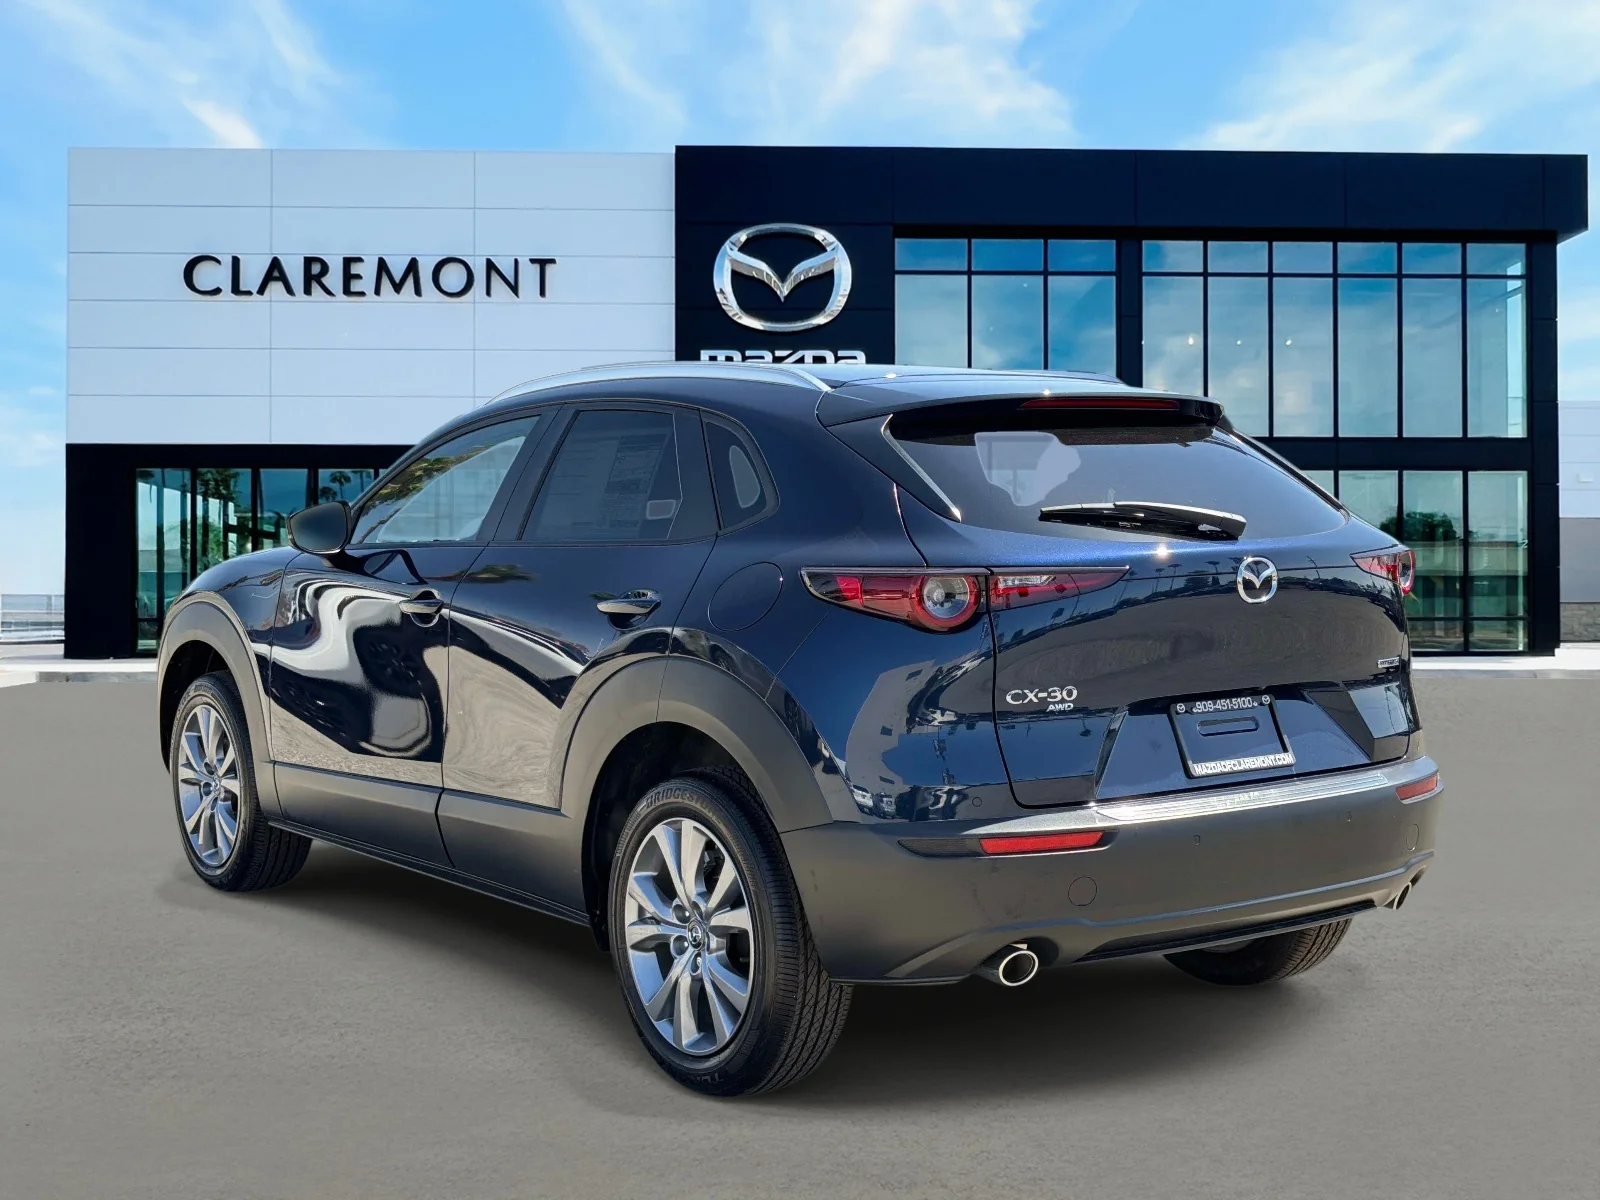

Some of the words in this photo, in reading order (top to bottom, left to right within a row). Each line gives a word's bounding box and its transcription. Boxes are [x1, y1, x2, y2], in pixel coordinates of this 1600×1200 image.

[183, 255, 557, 298] CLAREMONT
[1005, 685, 1078, 705] CX-30
[1046, 703, 1074, 712] AWD
[1196, 697, 1252, 712] 909-451-5100
